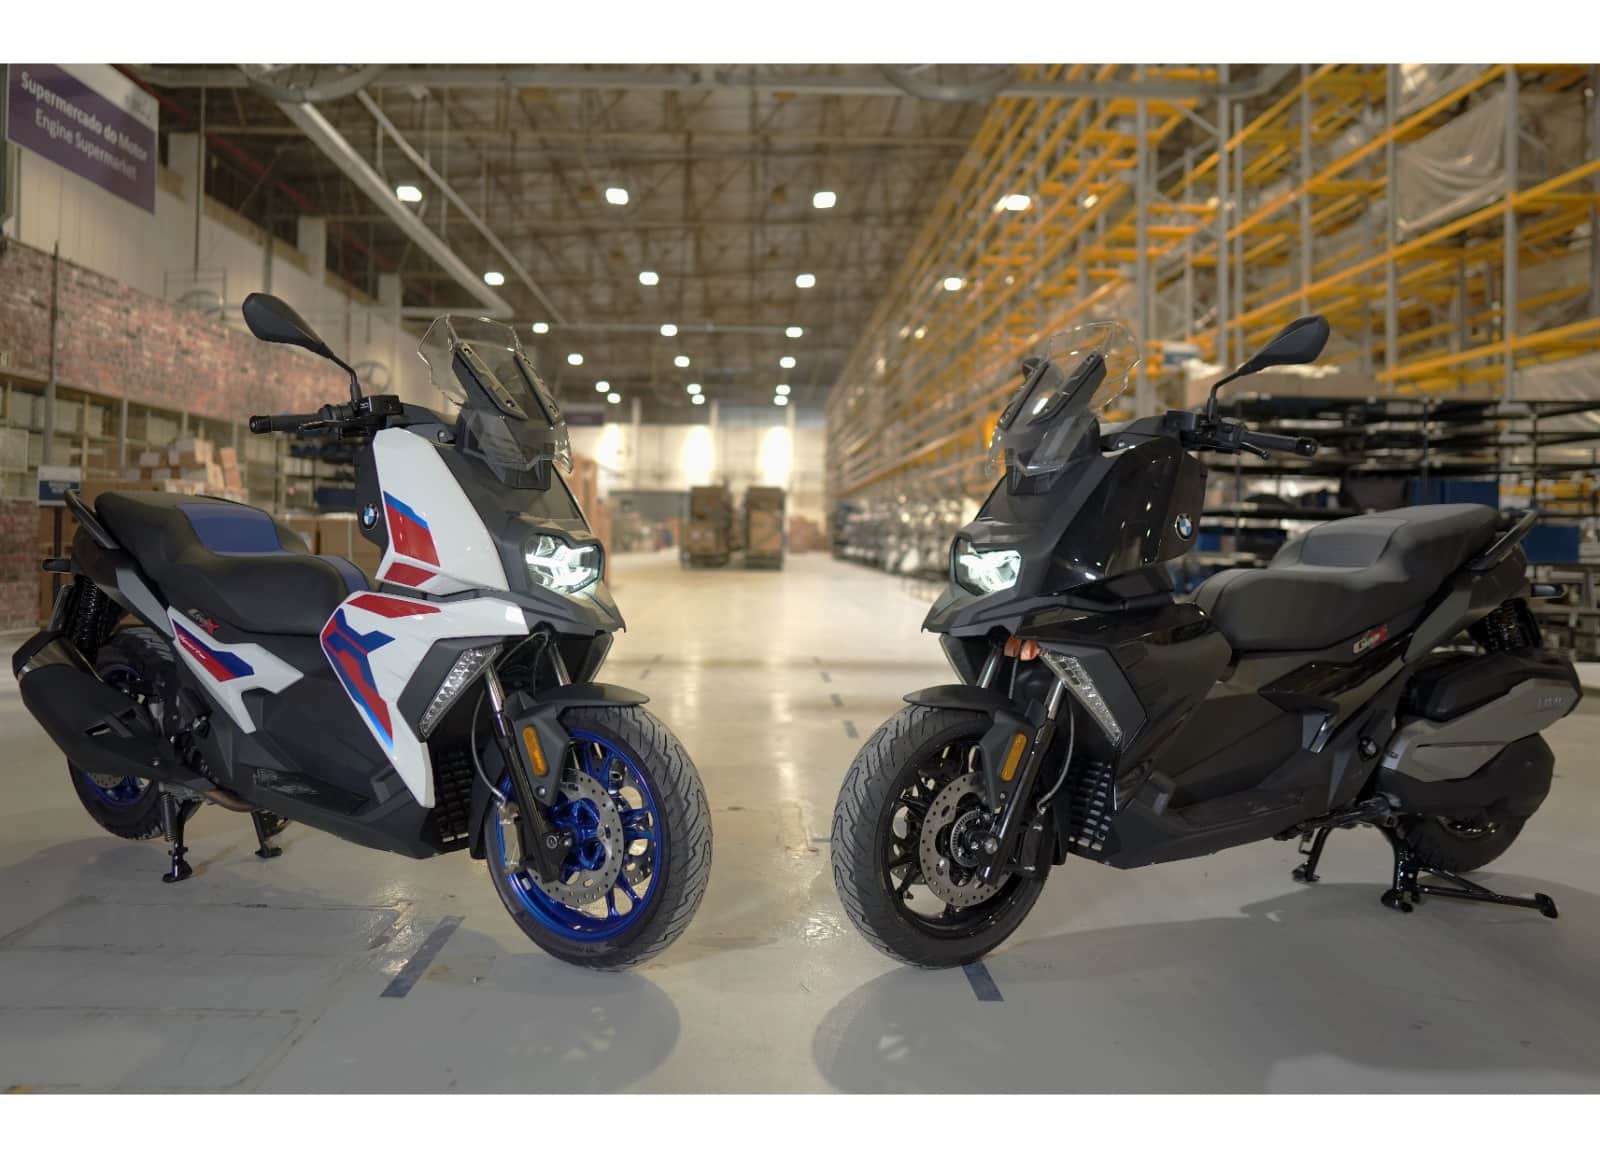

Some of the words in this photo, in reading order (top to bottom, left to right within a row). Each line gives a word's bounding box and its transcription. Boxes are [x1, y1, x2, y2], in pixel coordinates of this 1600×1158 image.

[21, 71, 102, 135] Supermercado
[104, 124, 117, 144] do
[35, 108, 73, 144] Engine
